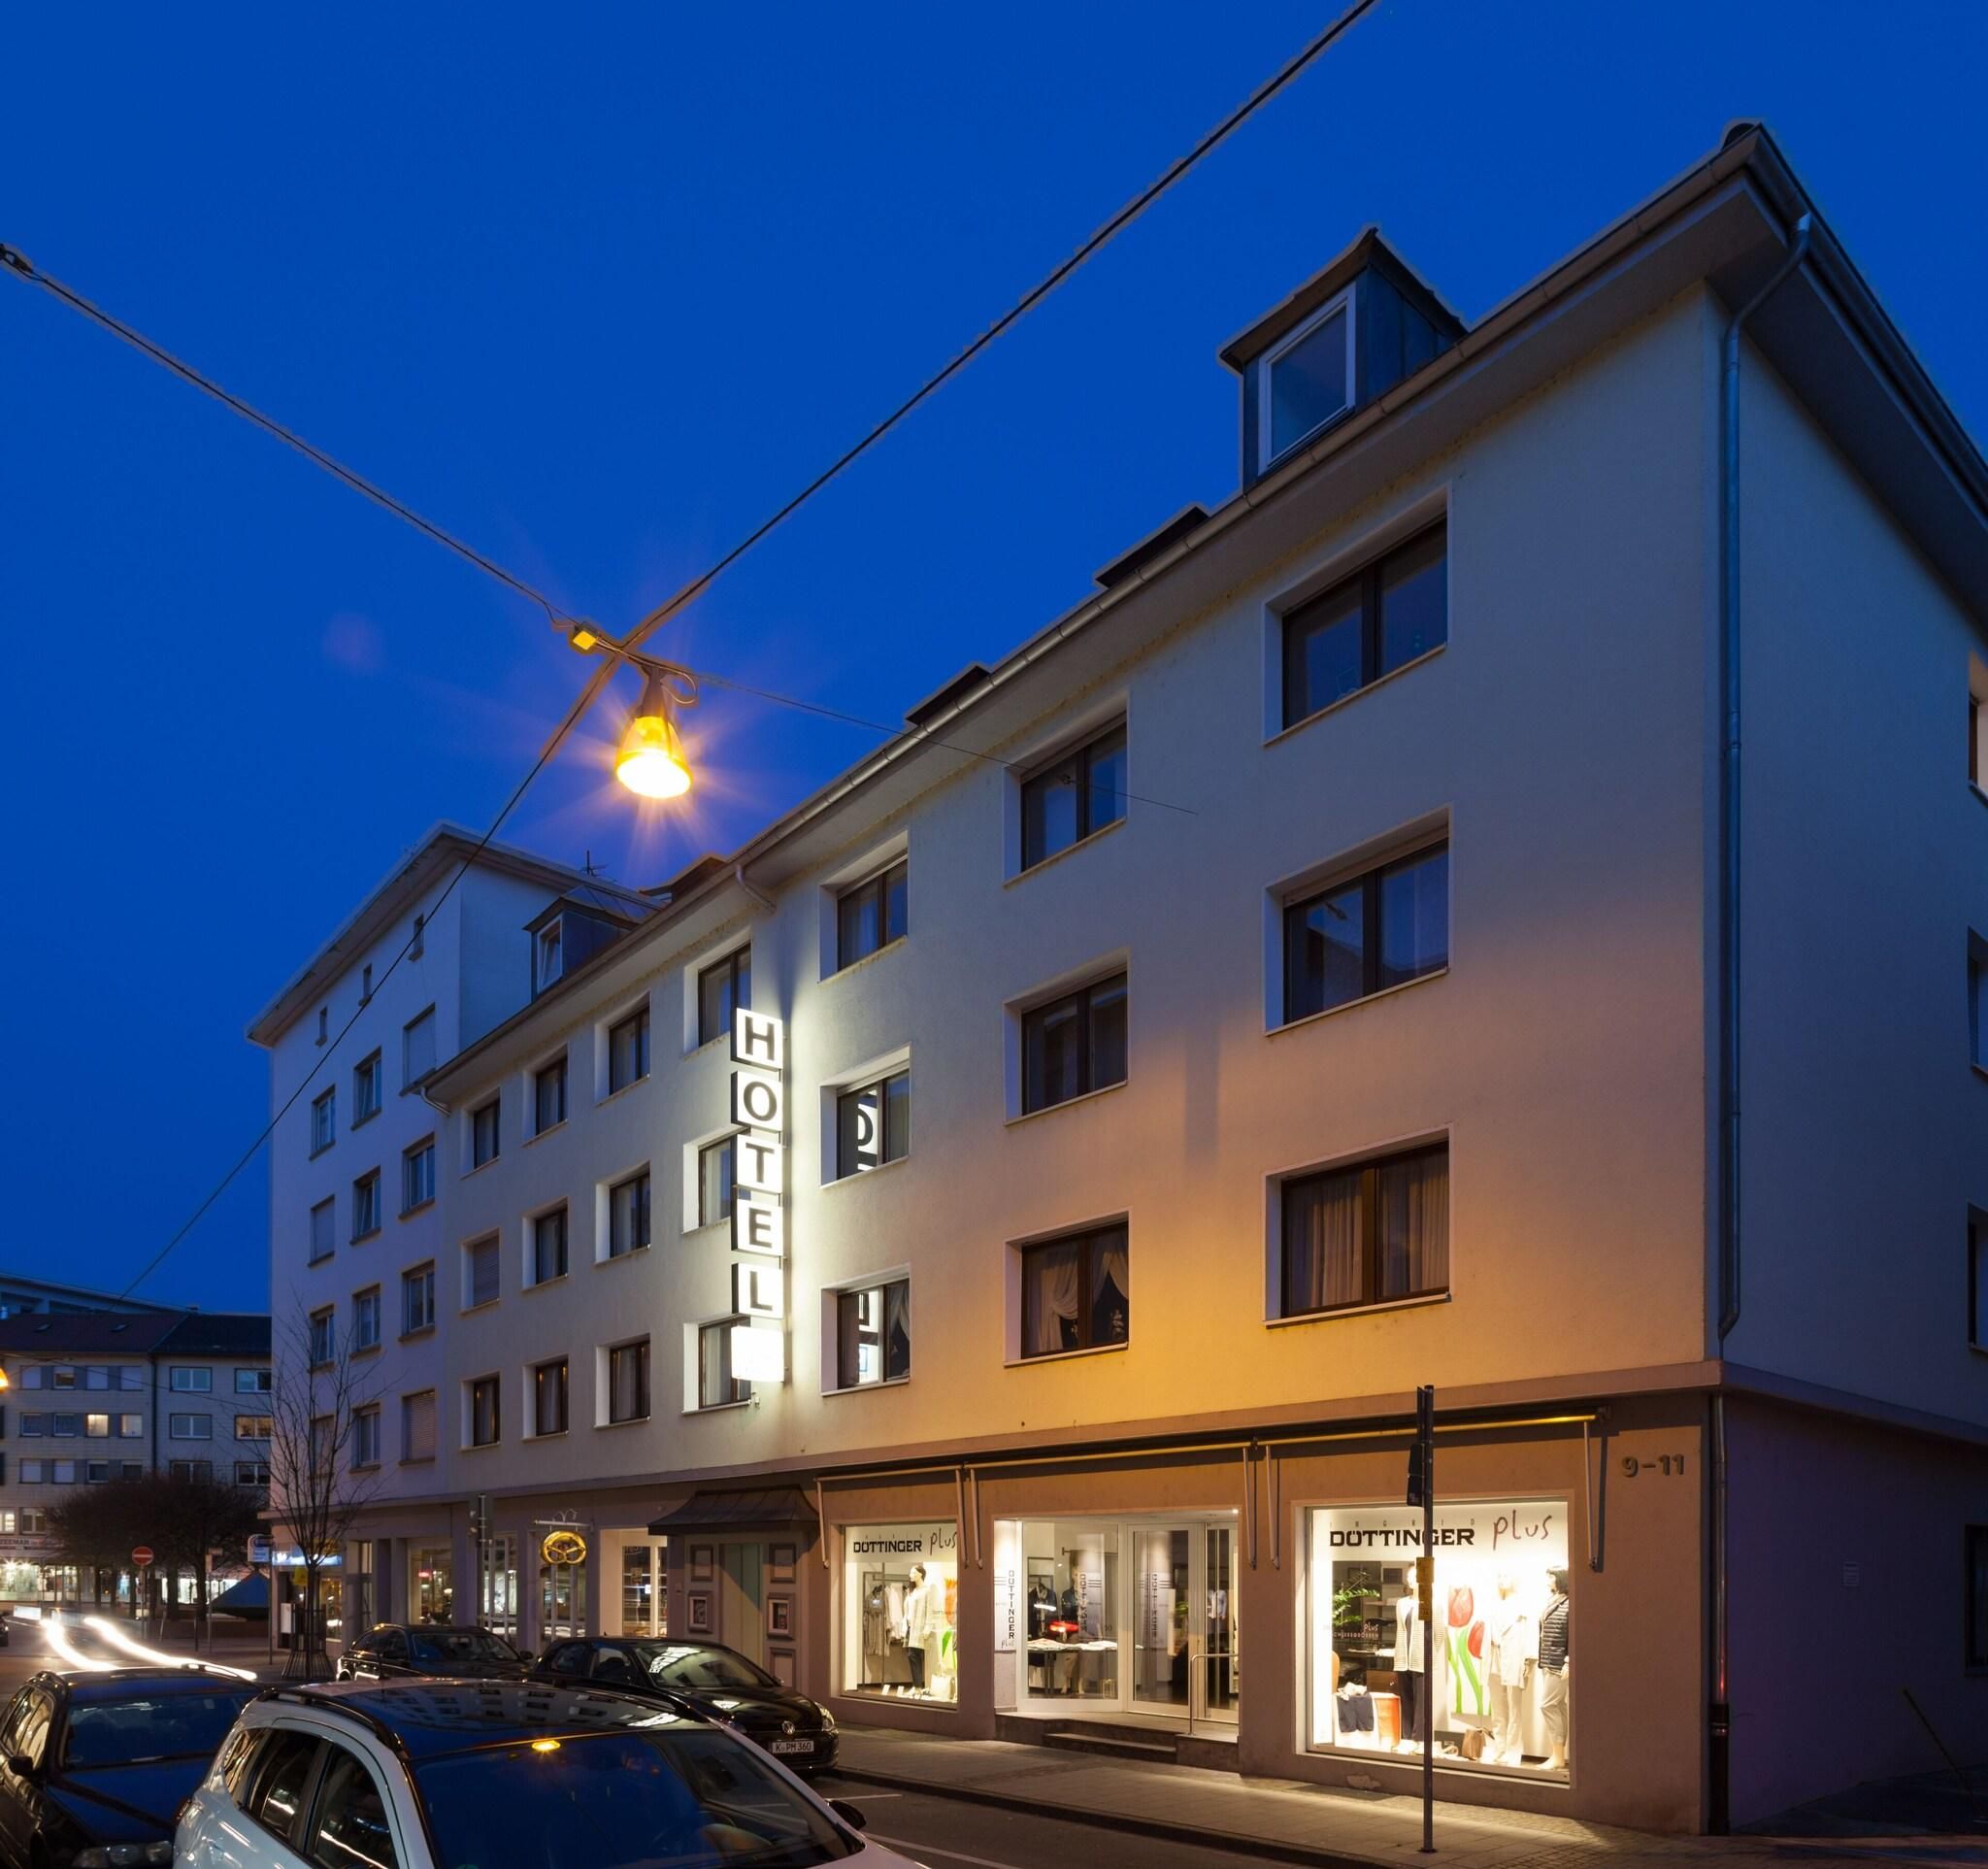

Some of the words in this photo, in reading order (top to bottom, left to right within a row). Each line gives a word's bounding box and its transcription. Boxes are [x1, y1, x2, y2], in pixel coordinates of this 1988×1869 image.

[743, 1017, 778, 1312] HOTEL
[1622, 1453, 1685, 1478] 9-11
[929, 1527, 957, 1555] plus
[1493, 1509, 1552, 1551] plus
